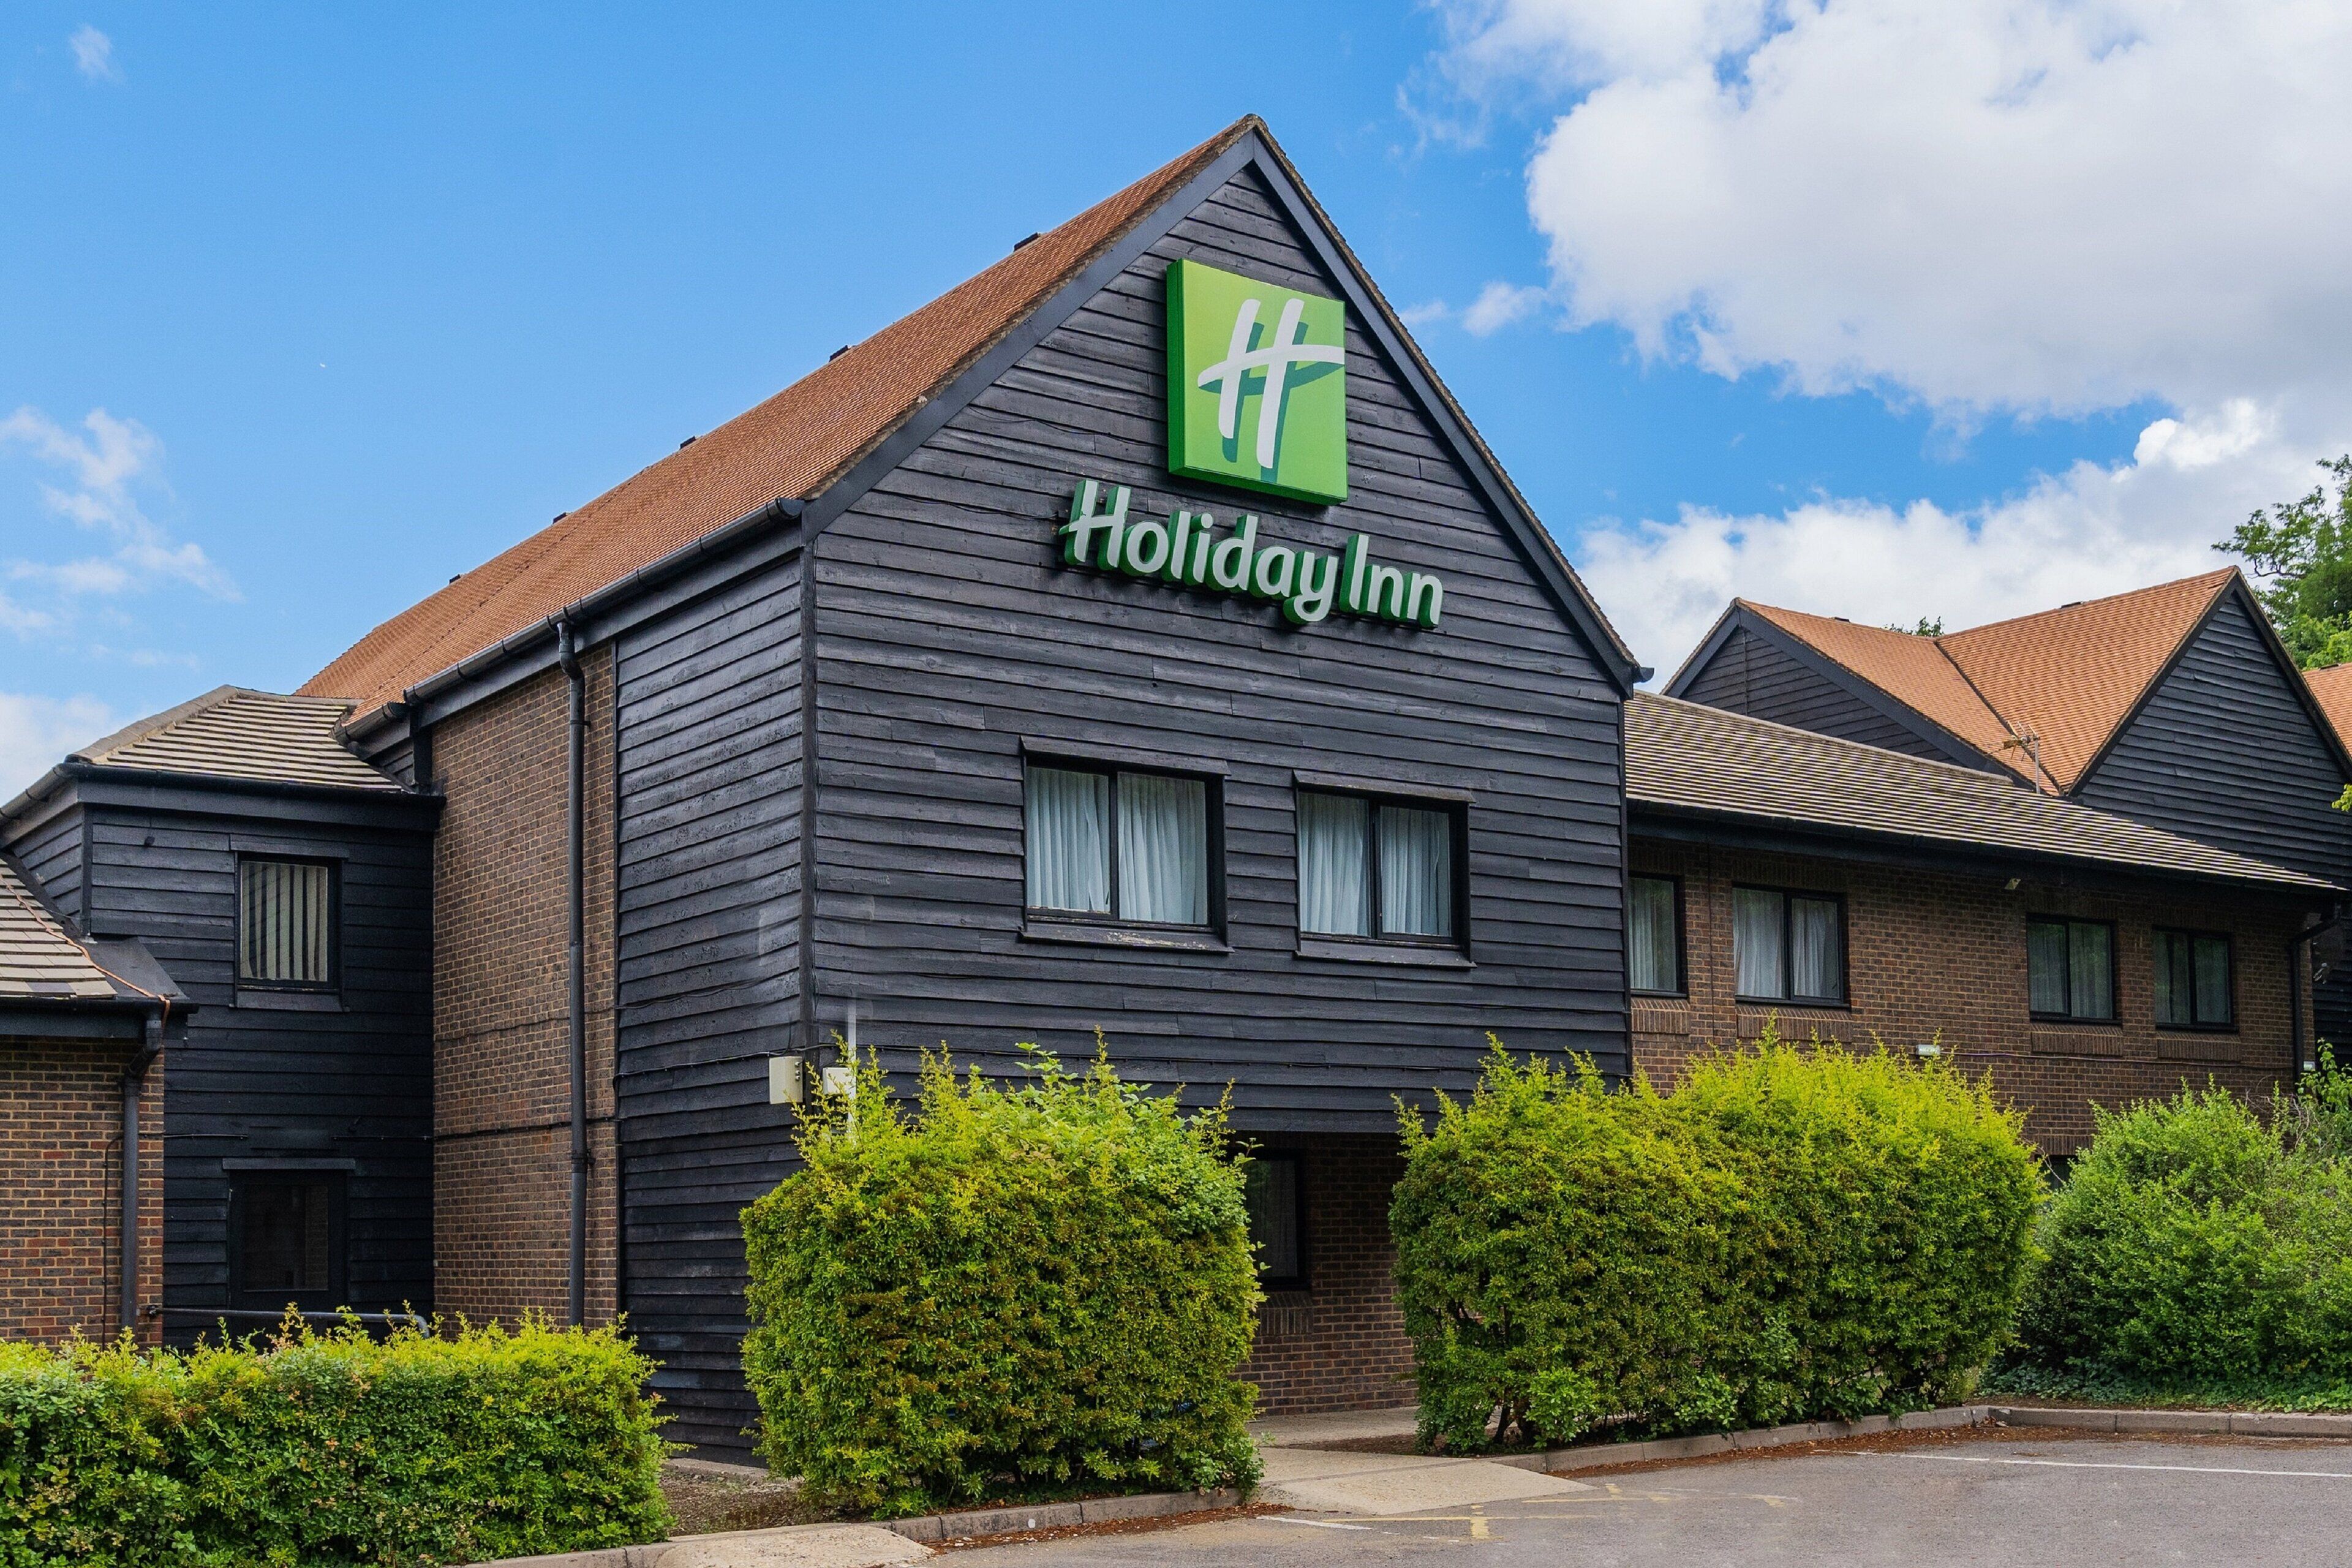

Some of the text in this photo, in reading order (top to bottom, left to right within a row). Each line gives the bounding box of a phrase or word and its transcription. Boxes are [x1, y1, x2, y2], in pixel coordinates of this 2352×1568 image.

[1198, 298, 1345, 469] H
[1059, 480, 1443, 627] Holiday Inn
